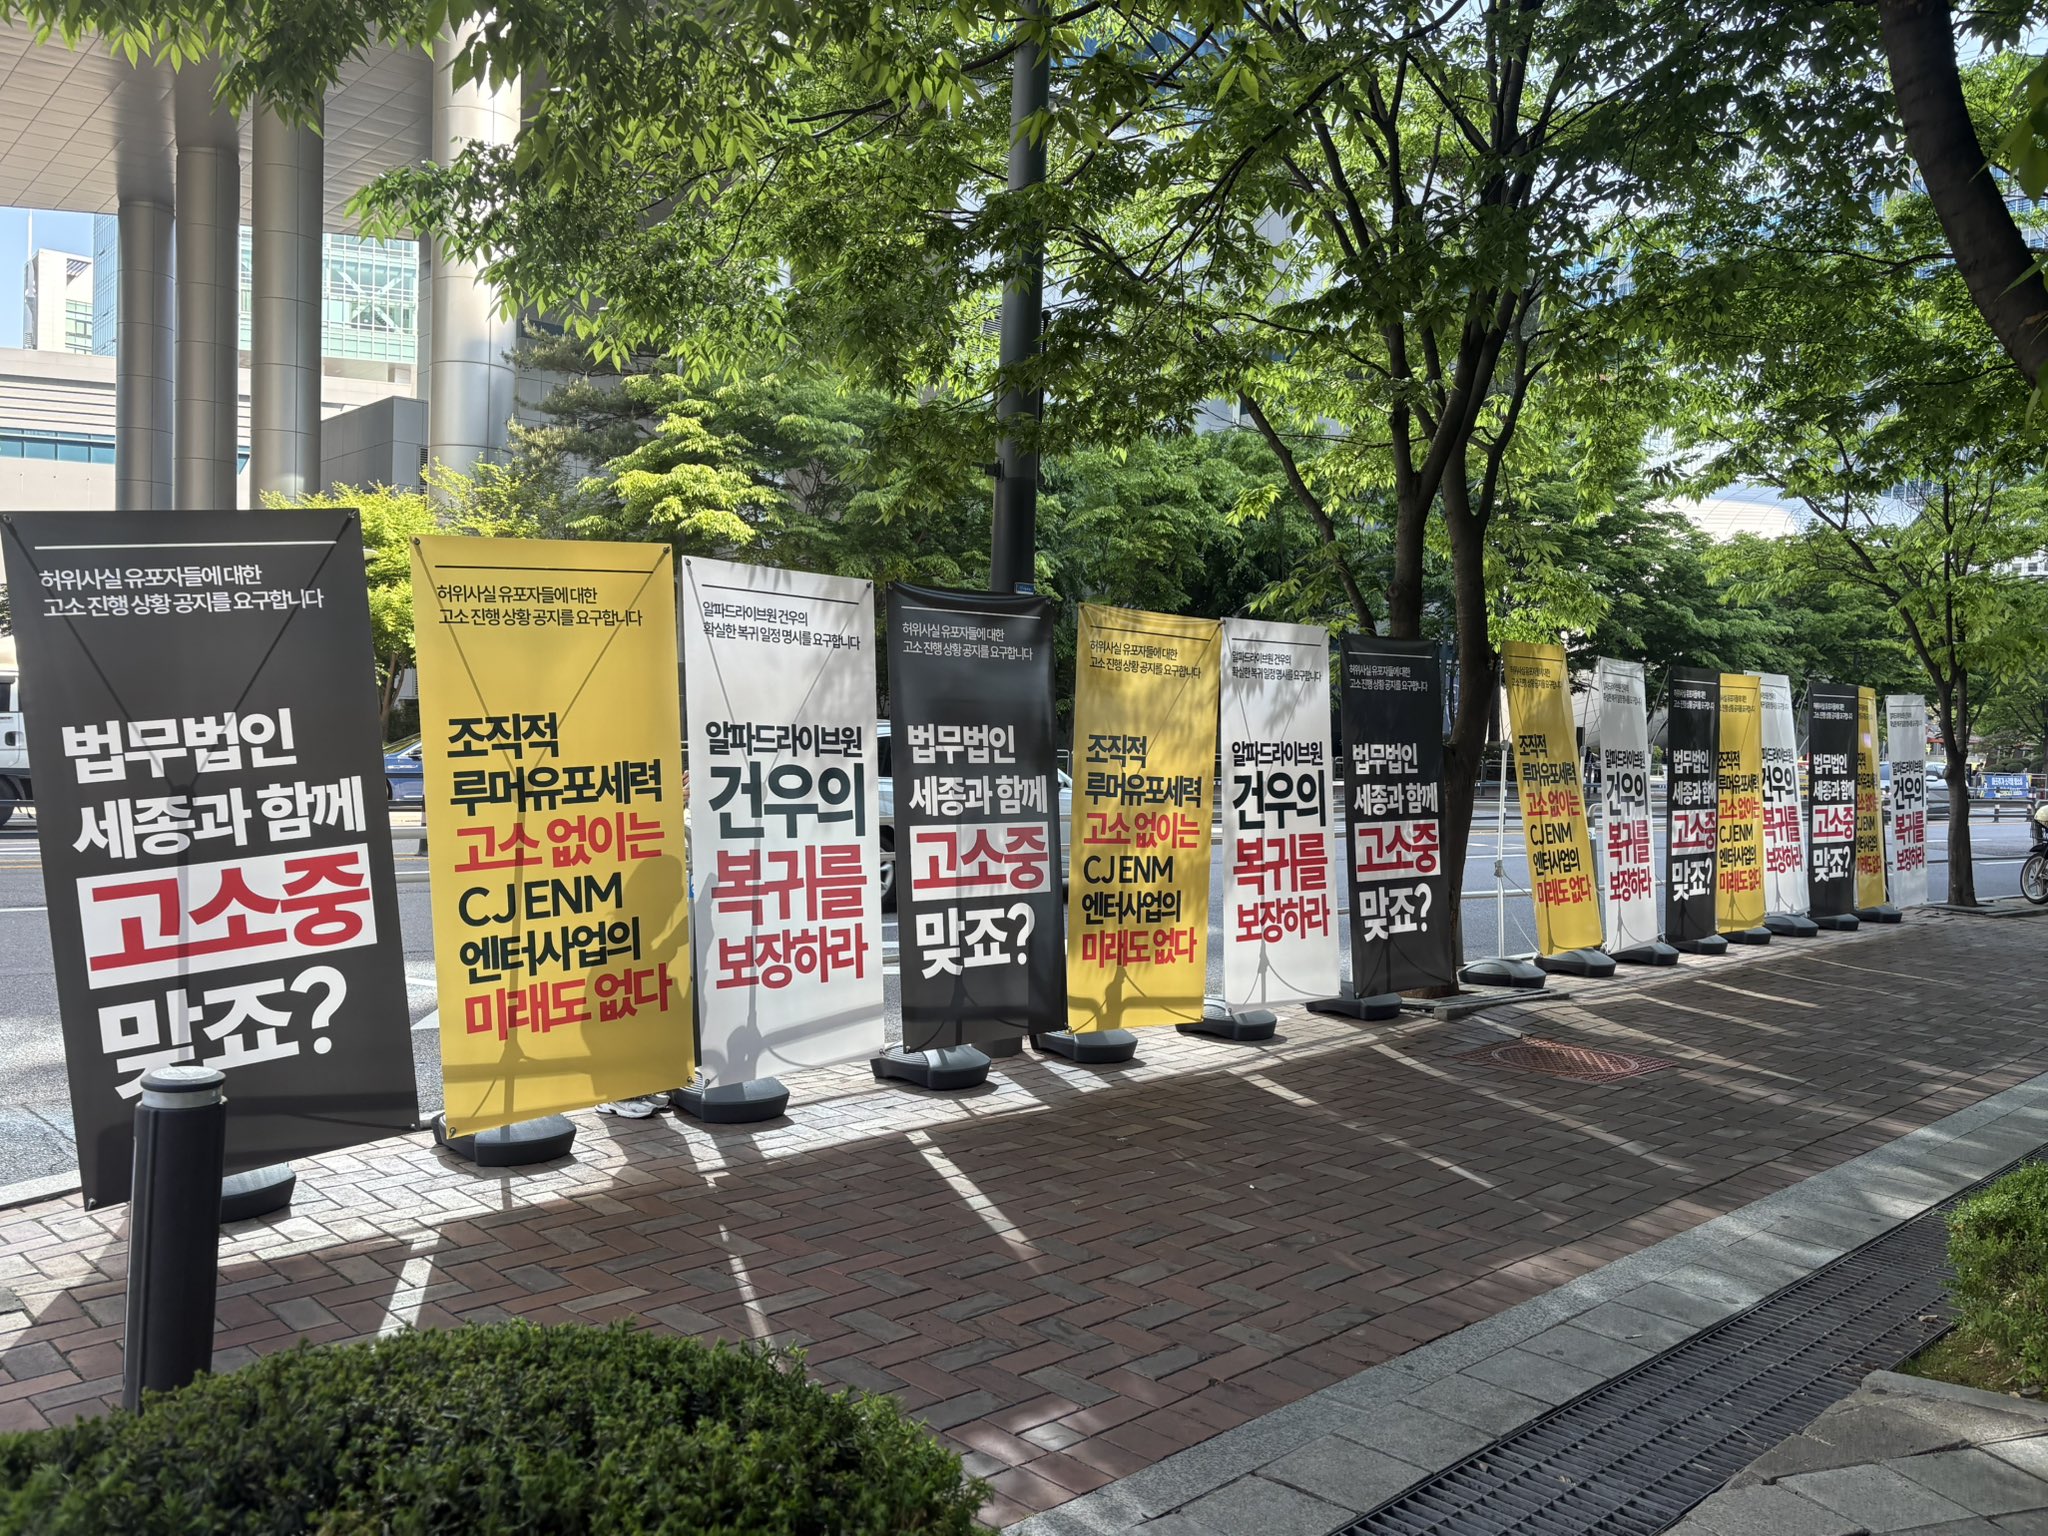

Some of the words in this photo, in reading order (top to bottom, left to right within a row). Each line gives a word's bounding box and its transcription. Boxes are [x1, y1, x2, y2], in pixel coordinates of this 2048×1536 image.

[39, 567, 122, 590] 허위사실
[125, 566, 222, 588] 유포자들에
[224, 565, 262, 586] 대한
[437, 584, 496, 603] 허위사실
[498, 585, 568, 604] 유포자들에
[570, 586, 597, 604] 대한
[43, 595, 87, 617] 고소
[90, 593, 128, 617] 진행
[131, 592, 171, 615] 상황
[173, 591, 231, 614] 공지를
[234, 587, 325, 612] 요구합니다
[438, 609, 469, 626] 고소
[471, 608, 500, 626] 진행
[502, 608, 531, 626] 상황
[533, 607, 574, 626] 공지를
[576, 608, 643, 628] 요구합니다
[702, 601, 777, 623] 알파드라이브원
[779, 607, 808, 627] 건우의
[703, 623, 737, 639] 확실한
[738, 624, 759, 643] 복귀
[761, 627, 781, 644] 일정
[782, 629, 812, 647] 명시를
[813, 631, 861, 651] 요구합니다
[902, 622, 940, 637] 허위사실
[941, 625, 986, 640] 유포자들에
[987, 629, 1004, 642] 대한
[1089, 639, 1122, 654] 허위사실
[1123, 642, 1161, 658] 유포자들에
[1162, 647, 1177, 658] 대한
[903, 640, 922, 653] 고소
[923, 642, 942, 656] 진행
[944, 643, 962, 657] 상황
[963, 644, 989, 658] 공지를
[990, 646, 1033, 661] 요구합니다
[1089, 657, 1105, 670] 고소
[1106, 658, 1122, 671] 진행
[1123, 660, 1139, 673] 상황
[1140, 661, 1162, 676] 공지를
[1163, 662, 1201, 679] 요구합니다
[1232, 651, 1273, 665] 알파드라이브원
[1274, 653, 1292, 665] 건우의
[1232, 666, 1251, 679] 확실한
[1252, 667, 1263, 679] 복귀
[1264, 667, 1275, 680] 일정
[1276, 668, 1293, 681] 명시를
[1294, 668, 1321, 683] 요구합니다
[61, 707, 297, 785] 법무법인
[447, 713, 560, 760] 조직적
[705, 721, 863, 758] 알파드라이브원
[907, 724, 1016, 764] 법무법인
[1086, 734, 1147, 765] 조직적
[1231, 741, 1323, 767] 알파드라이브원
[1519, 734, 1547, 757] 조직적
[1353, 743, 1418, 775] 법무법인
[1605, 749, 1645, 770] 알파드라이브원
[1673, 749, 1709, 774] 법무법인
[1762, 747, 1794, 764] 파드라이브원
[1813, 754, 1847, 774] 법무법인
[451, 759, 663, 818] 루머유포세력
[1084, 771, 1202, 808] 루머유포세력
[1522, 762, 1577, 786] 루머유포세력
[1762, 766, 1797, 802] 건우의
[1813, 780, 1839, 801] 세종과
[709, 763, 865, 839] 건우의
[909, 777, 993, 817] 세종과
[996, 774, 1048, 815] 함께
[1233, 770, 1325, 830] 건우의
[1354, 784, 1404, 817] 세종과
[1407, 781, 1438, 814] 함께
[1527, 794, 1548, 817] 고소
[1549, 791, 1581, 817] 없이는
[1606, 771, 1648, 817] 건우의
[1672, 780, 1701, 806] 세종과
[1719, 799, 1737, 820] 고소
[1738, 796, 1760, 820] 없이는
[1894, 776, 1924, 810] 건우의
[73, 787, 252, 860] 세종과
[260, 776, 367, 841] 함께
[1084, 814, 1130, 845] 고소
[1135, 813, 1200, 849] 없이는
[1530, 824, 1544, 845] CJ
[1545, 823, 1572, 844] ENM
[1672, 814, 1716, 851] 고소중
[1719, 826, 1732, 842] CJ
[1733, 824, 1753, 841] ENM
[1763, 805, 1800, 844] 복귀를
[1813, 805, 1854, 840] 고소중
[1895, 811, 1924, 845] 복귀를
[453, 825, 543, 873] 고소
[548, 812, 665, 868] 없이는
[913, 825, 1048, 890] 고소중
[1357, 822, 1439, 874] 고소중
[1608, 819, 1649, 866] 복귀를
[1719, 844, 1756, 868] 엔터사업의
[1766, 844, 1803, 874] 보장하라
[1897, 845, 1924, 872] 보장하라
[1083, 857, 1115, 884] CJ
[1121, 857, 1173, 883] ENM
[1233, 833, 1329, 895] 복귀를
[1533, 849, 1580, 877] 엔터사업의
[1672, 857, 1712, 902] 맞죠?
[1719, 870, 1748, 894] 미래도
[1749, 867, 1761, 890] 없다
[1813, 846, 1851, 883] 맞죠?
[458, 885, 516, 926] CJ
[525, 872, 622, 920] ENM
[712, 844, 868, 924] 복귀를
[1537, 879, 1568, 907] 미래도
[1569, 875, 1592, 903] 없다
[1610, 866, 1652, 904] 보장하라
[88, 851, 371, 972] 고소중
[1081, 890, 1181, 925] 엔터사업의
[1236, 893, 1330, 943] 보장하라
[1359, 883, 1432, 943] 맞죠?
[459, 919, 642, 983] 엔터사업의
[716, 923, 869, 989] 보장하라
[916, 902, 1035, 980] 맞죠?
[1082, 929, 1150, 968] 미래도
[1153, 927, 1197, 965] 없다
[466, 980, 592, 1040] 미래도
[595, 963, 673, 1024] 없다
[97, 965, 348, 1102] 맞죠?
